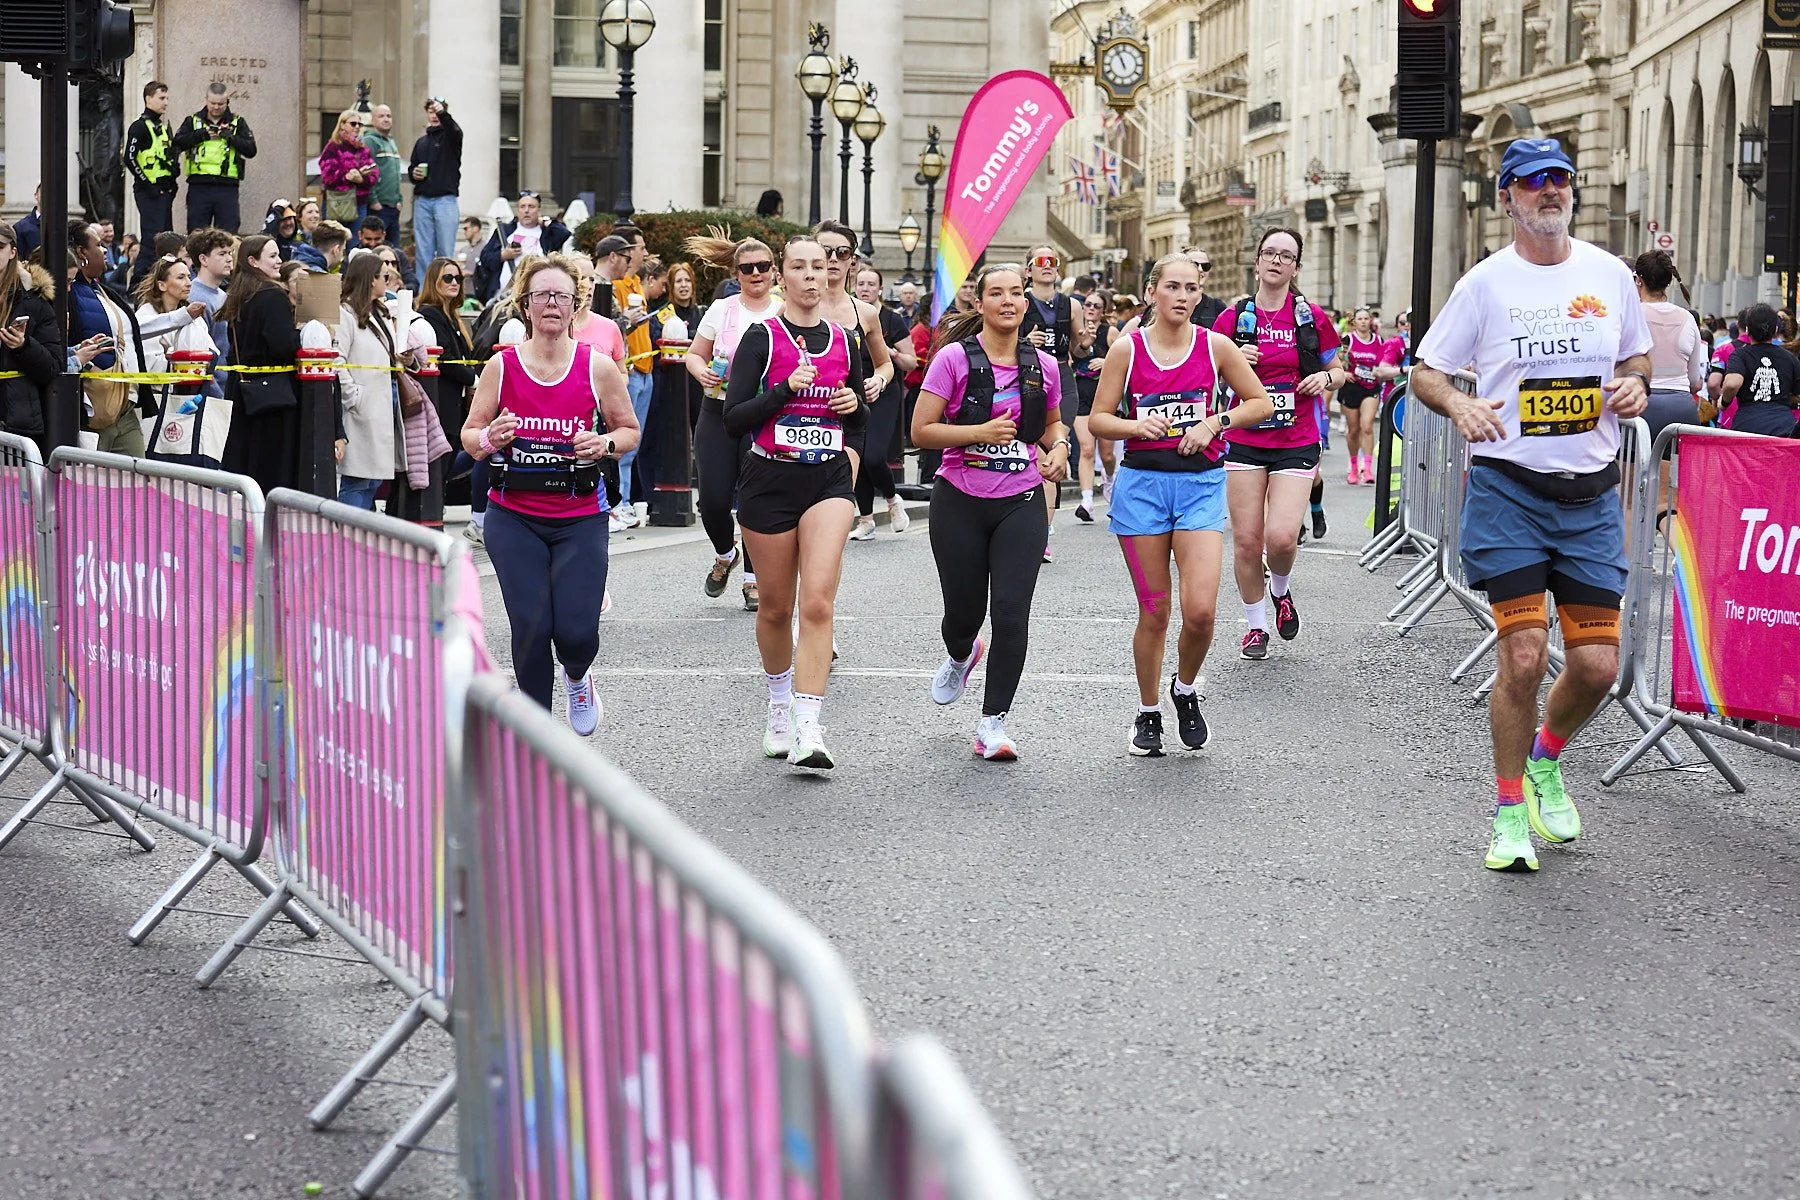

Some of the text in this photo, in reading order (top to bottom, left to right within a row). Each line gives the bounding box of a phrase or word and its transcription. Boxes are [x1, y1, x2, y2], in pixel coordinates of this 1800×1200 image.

[200, 56, 267, 69] ERECTED
[210, 73, 245, 84] JUNE
[129, 137, 147, 181] POLICE
[961, 99, 1040, 203] Tommy's
[983, 112, 1054, 214] The pregnancy and baby charity
[1509, 304, 1560, 323] Road
[1524, 319, 1595, 336] Victims
[1510, 336, 1581, 358] Trust
[1512, 361, 1536, 370] Giving
[1537, 359, 1558, 367] hope
[1569, 355, 1597, 363] rebuild
[1551, 380, 1572, 388] PAUL
[1159, 393, 1182, 401] ETOILE
[1526, 394, 1595, 416] 13401
[508, 412, 586, 437] ommy's
[800, 416, 821, 424] CHLOE
[785, 428, 833, 447] 9880
[1503, 606, 1539, 618] BEARHUG
[1725, 598, 1745, 620] The
[1579, 621, 1615, 629] BEARHUG
